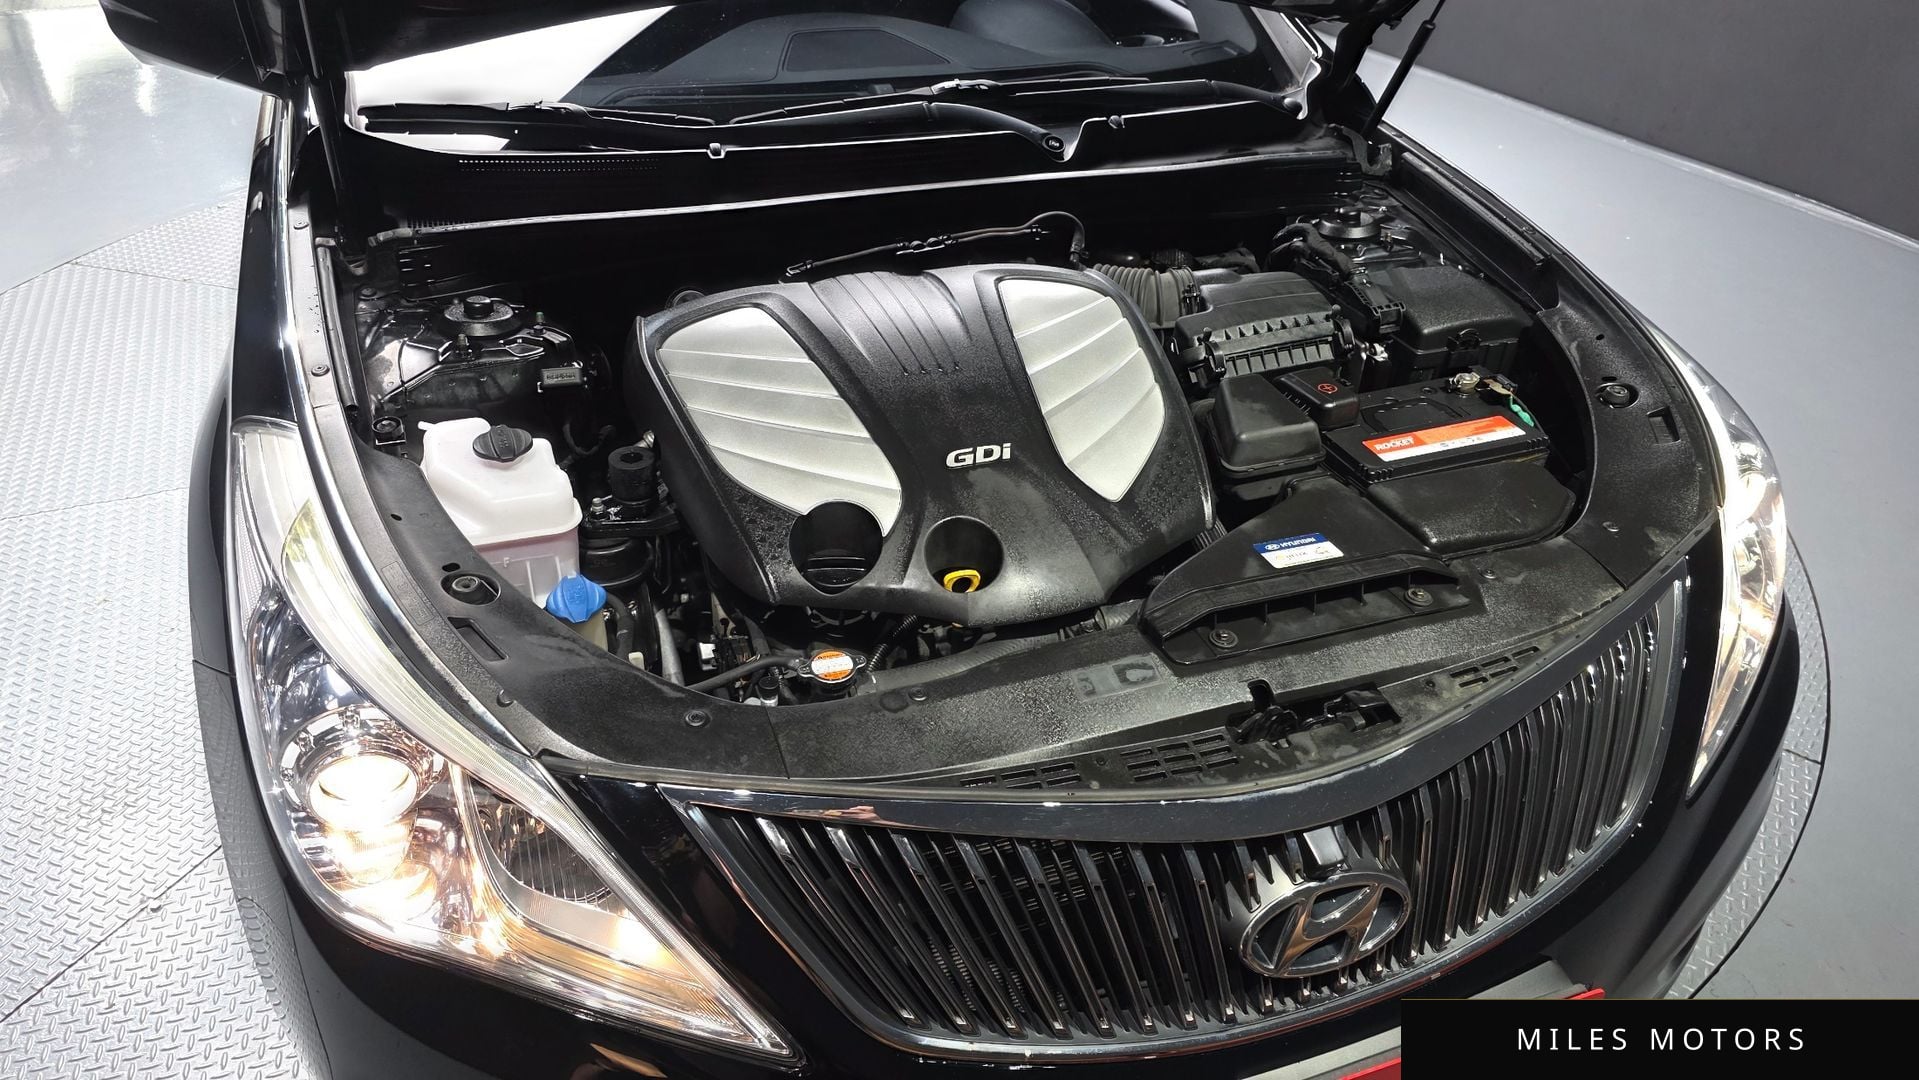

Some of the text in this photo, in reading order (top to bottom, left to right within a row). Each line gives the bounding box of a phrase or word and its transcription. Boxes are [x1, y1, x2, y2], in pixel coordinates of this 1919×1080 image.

[1374, 435, 1415, 451] ROCKET
[946, 442, 1012, 467] GDi
[1280, 537, 1317, 548] HYUNDAI
